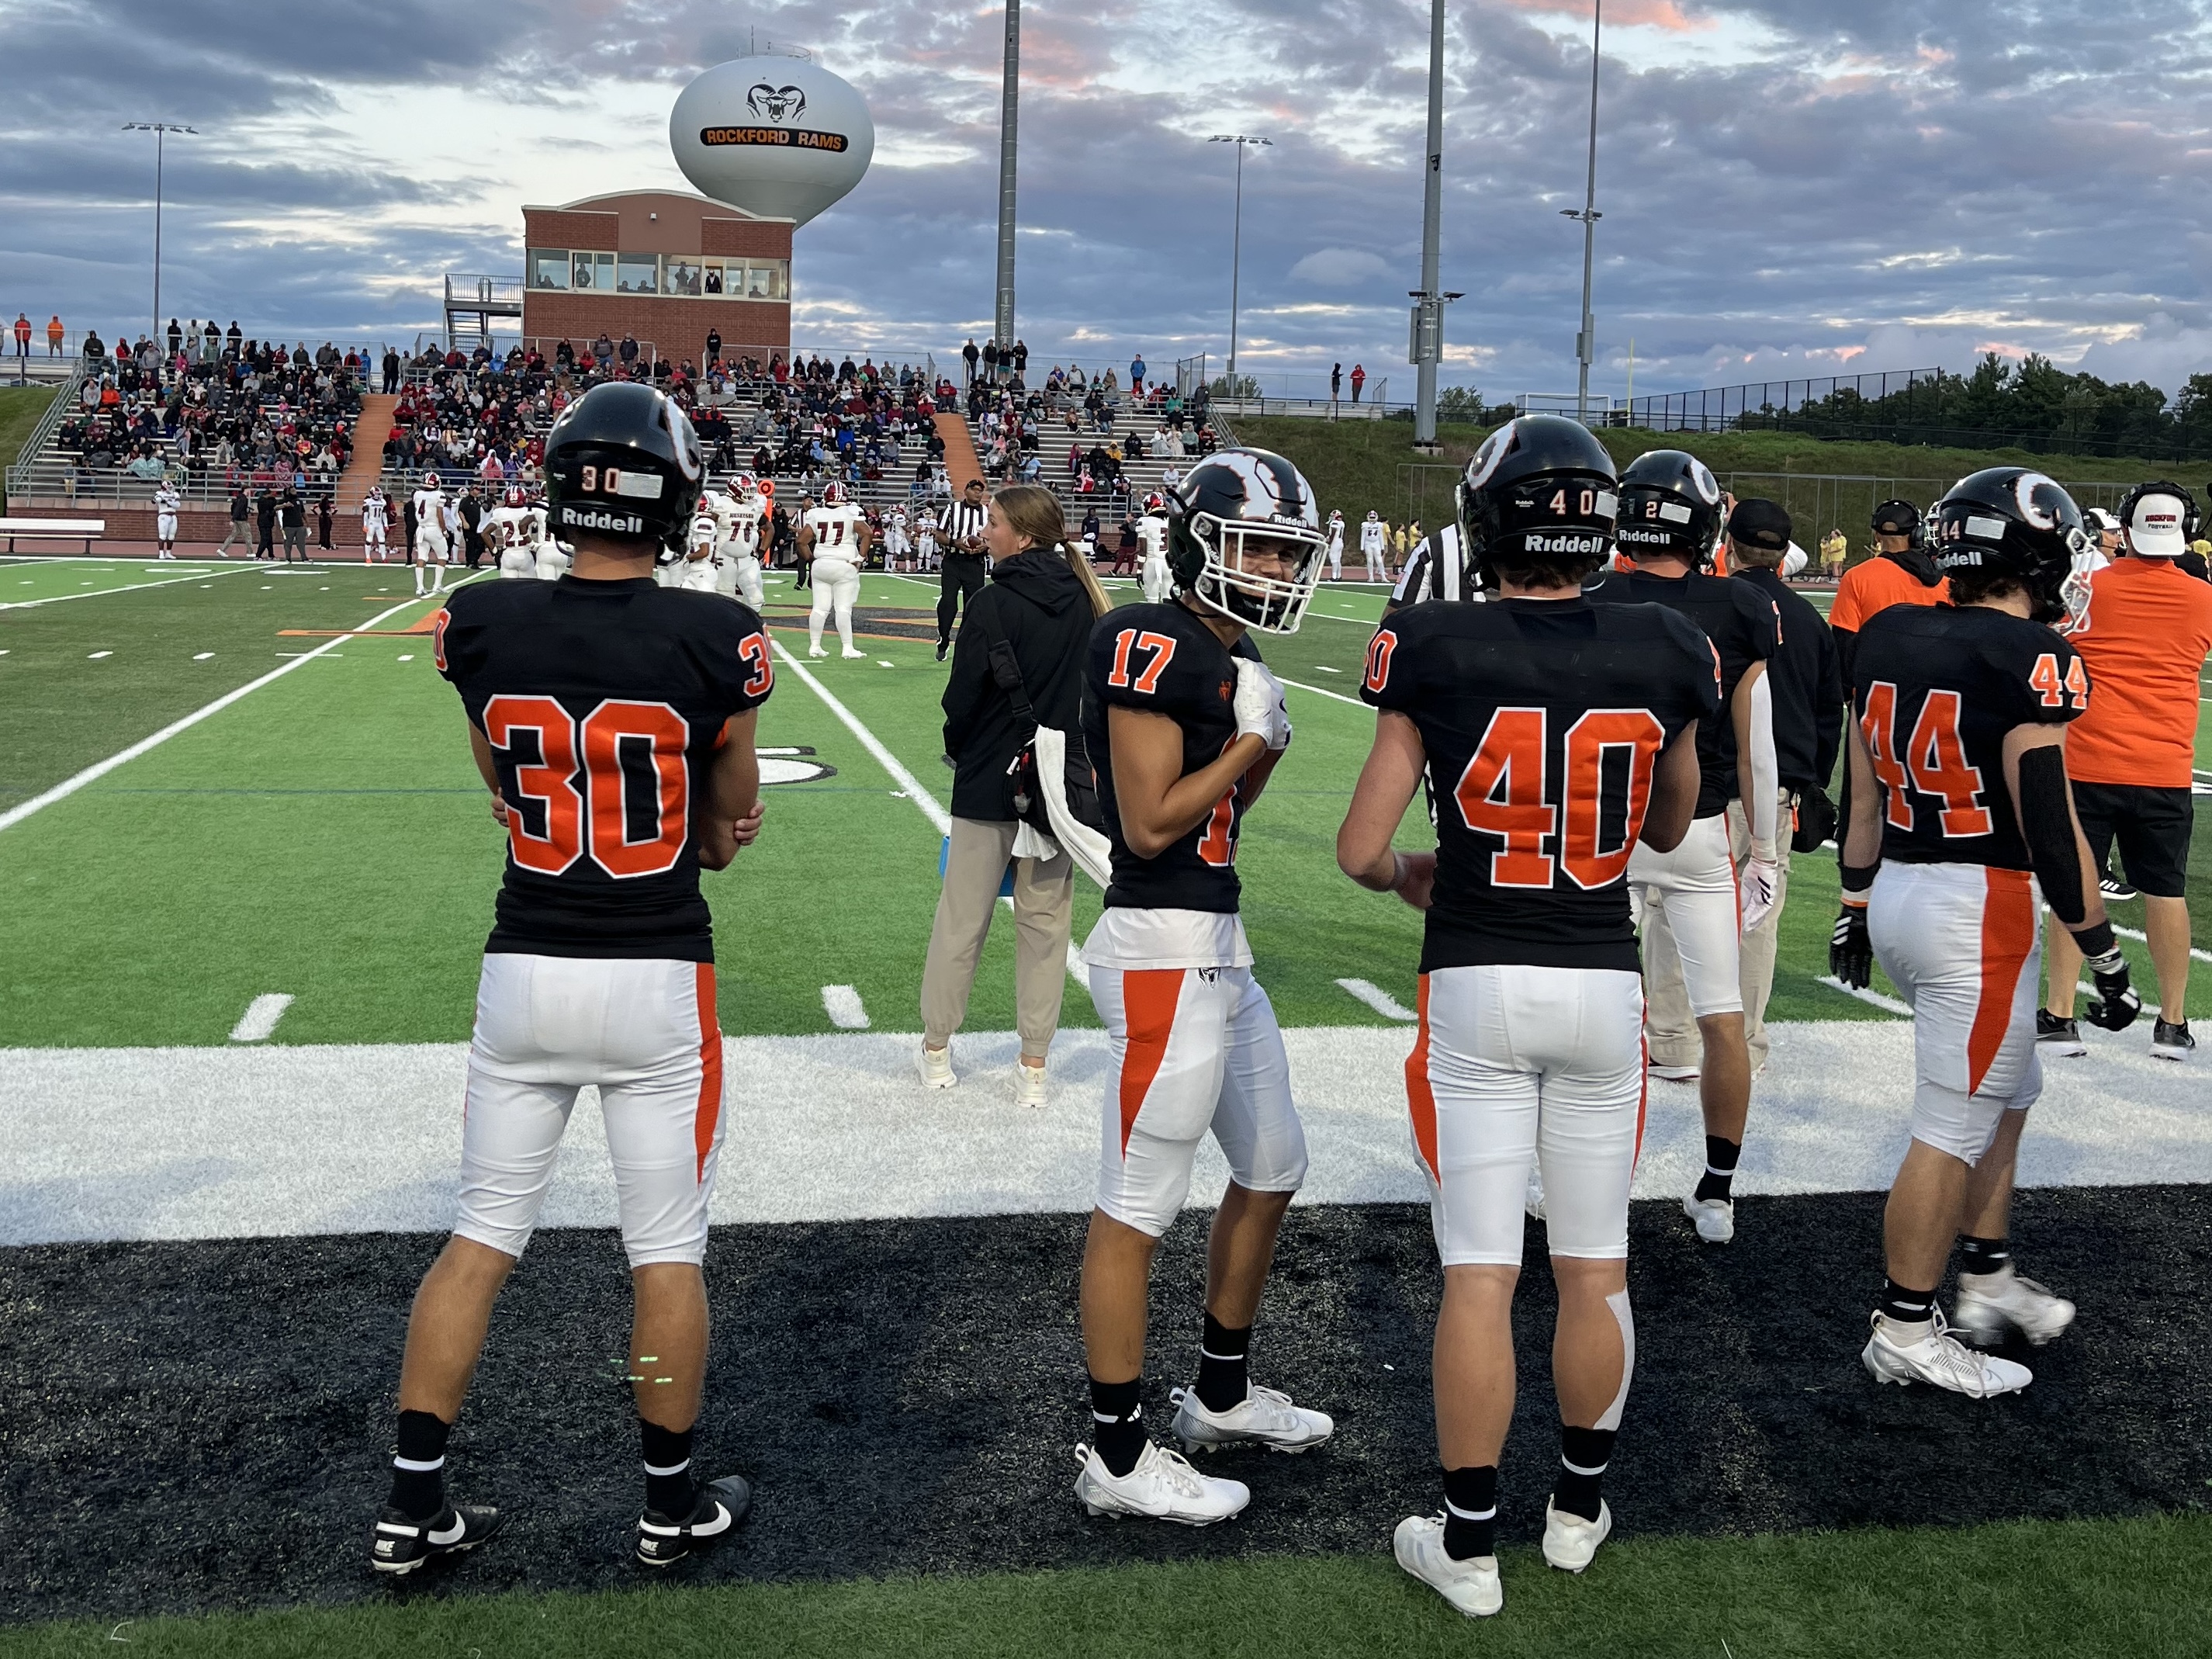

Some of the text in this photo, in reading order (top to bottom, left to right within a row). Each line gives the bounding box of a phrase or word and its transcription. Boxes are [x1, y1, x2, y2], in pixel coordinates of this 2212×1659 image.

[707, 129, 842, 150] ROCKFORD RAMS
[581, 465, 621, 493] 30
[418, 499, 426, 519] 4
[834, 493, 843, 501] 77
[1549, 489, 1593, 515] 40
[1646, 500, 1657, 518] 2
[562, 507, 643, 534] Riddell
[1273, 514, 1307, 528] Riddell
[1940, 520, 1961, 541] 44
[817, 521, 844, 545] 77
[1525, 535, 1604, 553] Riddell
[1618, 529, 1670, 544] Riddell
[1107, 628, 1178, 694] 17
[2027, 653, 2089, 709] 44
[1860, 680, 1994, 838] 44
[483, 694, 690, 879] 30
[1454, 707, 1666, 890] 40
